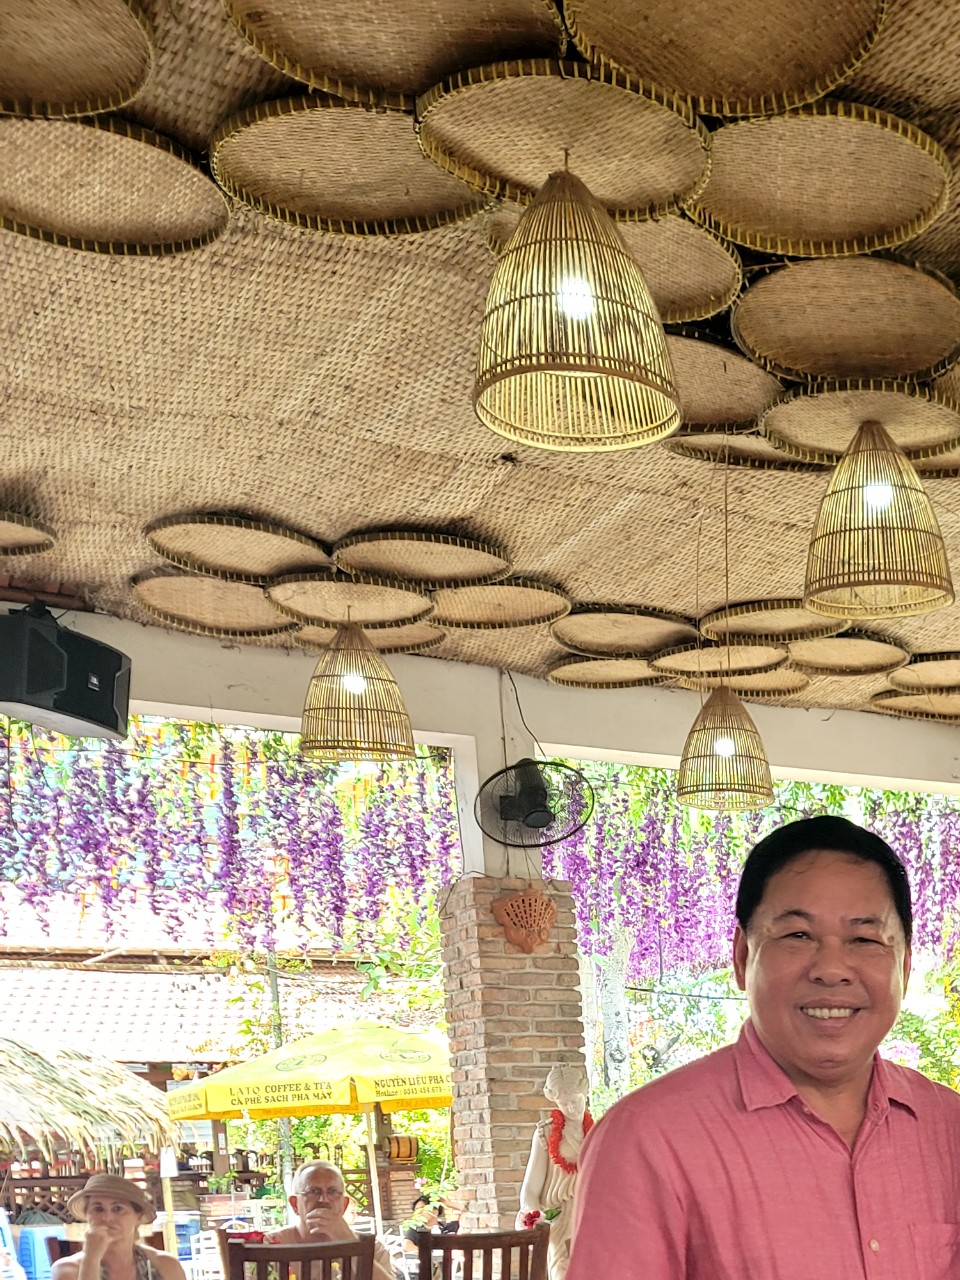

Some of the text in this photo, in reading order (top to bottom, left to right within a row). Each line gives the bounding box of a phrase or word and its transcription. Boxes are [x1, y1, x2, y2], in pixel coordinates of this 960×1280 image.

[265, 1083, 302, 1094] COFFEE
[304, 1082, 311, 1091] &
[291, 1093, 310, 1102] PHA
